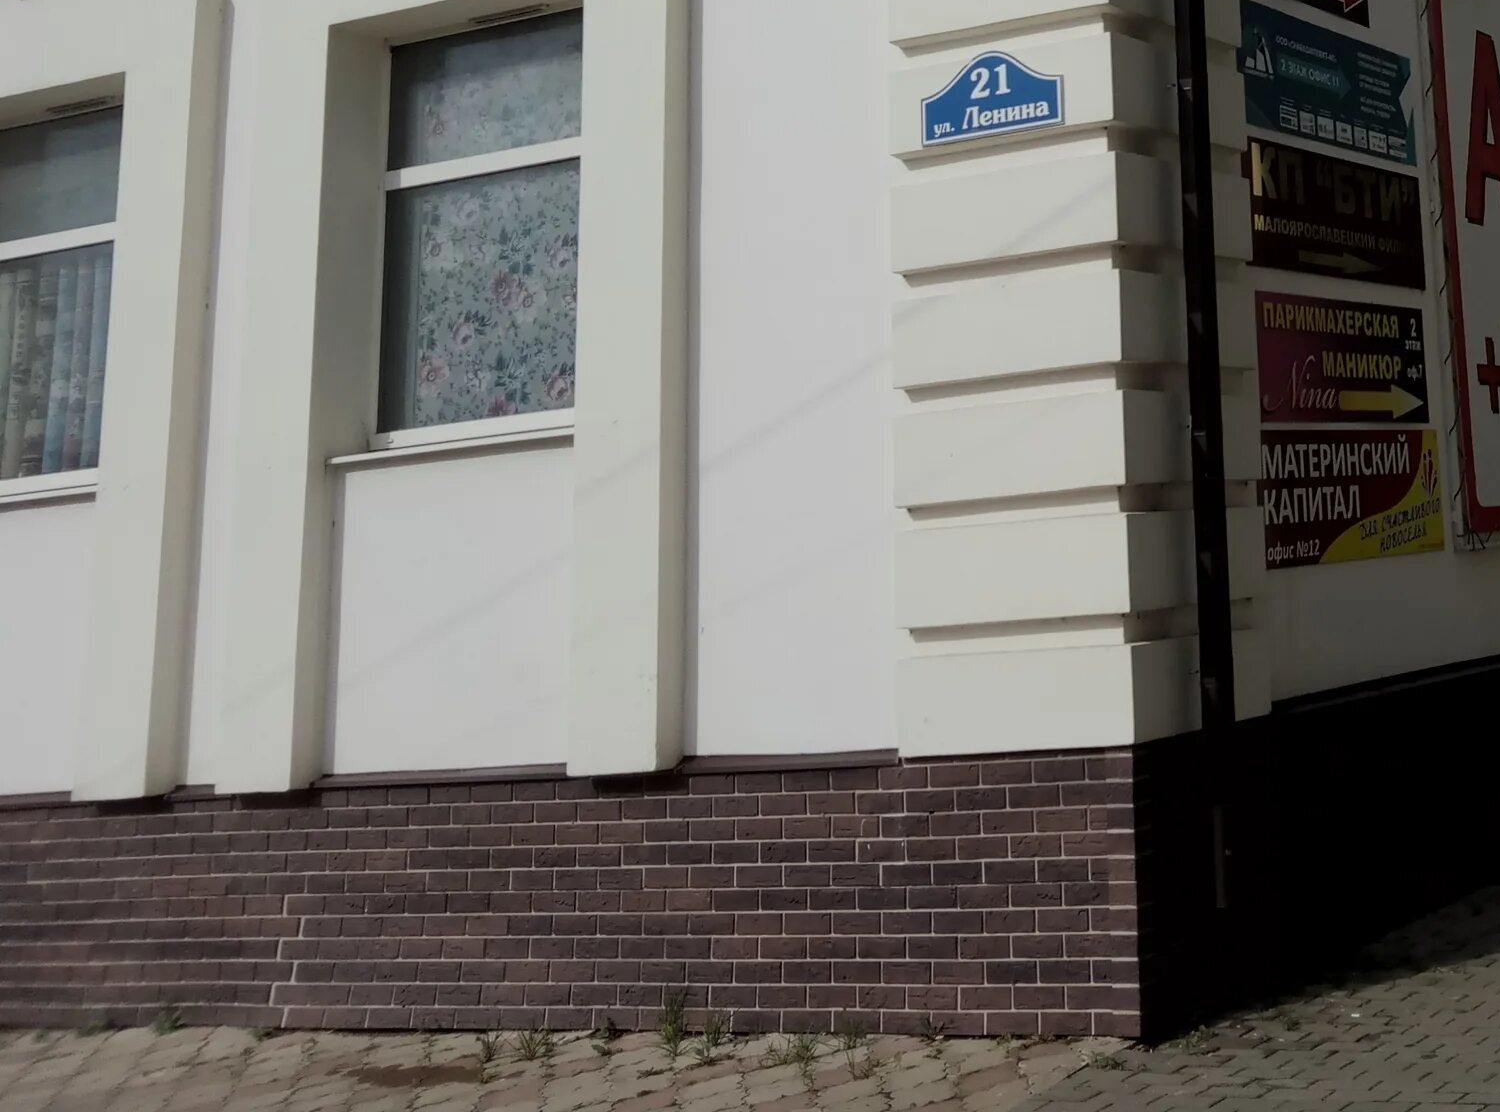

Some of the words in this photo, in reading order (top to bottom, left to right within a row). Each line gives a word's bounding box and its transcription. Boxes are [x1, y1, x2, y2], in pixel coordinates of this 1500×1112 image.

[970, 63, 1011, 99] 21
[933, 123, 955, 137] ул.
[962, 101, 1049, 129] Ленина
[1251, 141, 1304, 206] КП
[1263, 301, 1400, 338] ПАРИКМАХЕРСКАЯ
[1409, 318, 1417, 337] 2
[1322, 349, 1401, 380] МАНИКЮР
[1262, 355, 1337, 412] Nina
[1261, 433, 1410, 480] МАТЕРИНСКИЙ
[1263, 484, 1361, 526] КАПИТАЛ
[1267, 541, 1295, 564] офис
[1296, 539, 1320, 558] №12
